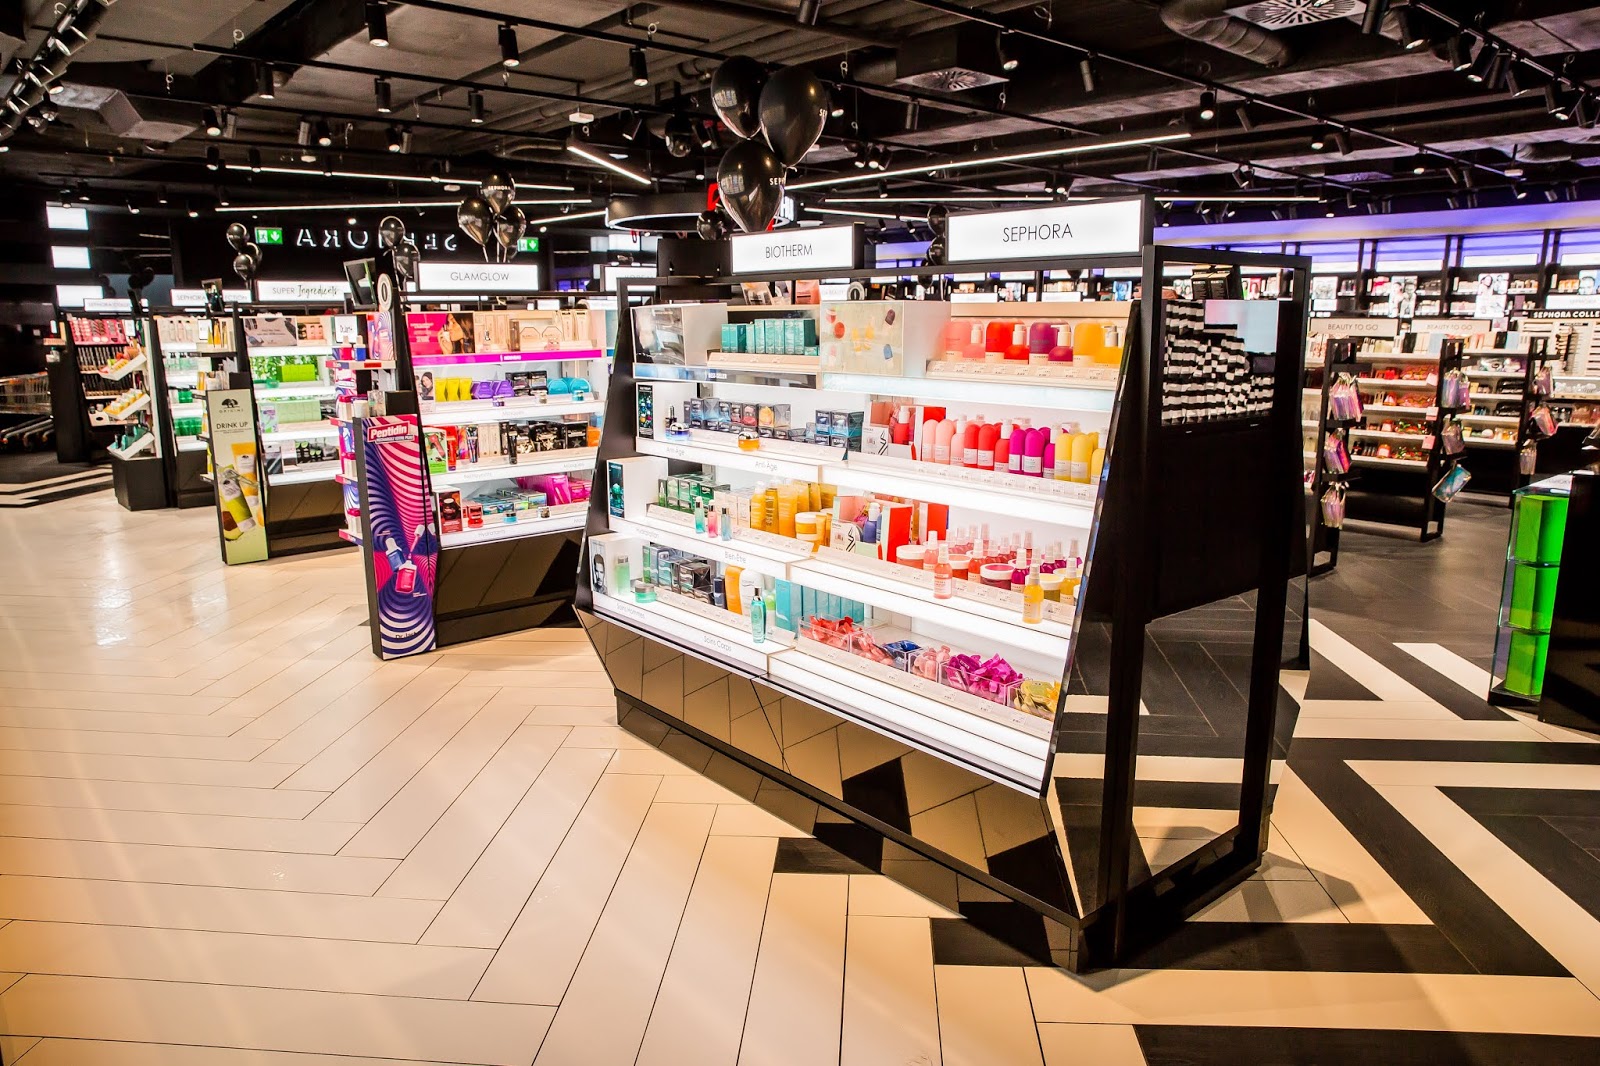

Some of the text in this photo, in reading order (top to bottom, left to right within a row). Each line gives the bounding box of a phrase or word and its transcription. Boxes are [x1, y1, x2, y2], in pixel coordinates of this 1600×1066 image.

[1002, 223, 1074, 242] SEPHORA
[765, 244, 813, 259] BIOTHERM
[450, 272, 510, 282] GLAMGLOW
[272, 287, 295, 295] SUPER
[1533, 310, 1600, 319] SEPHORA COLLE
[1366, 323, 1379, 331] GO
[216, 421, 249, 430] DRINK UP
[370, 424, 408, 440] Peptidin
